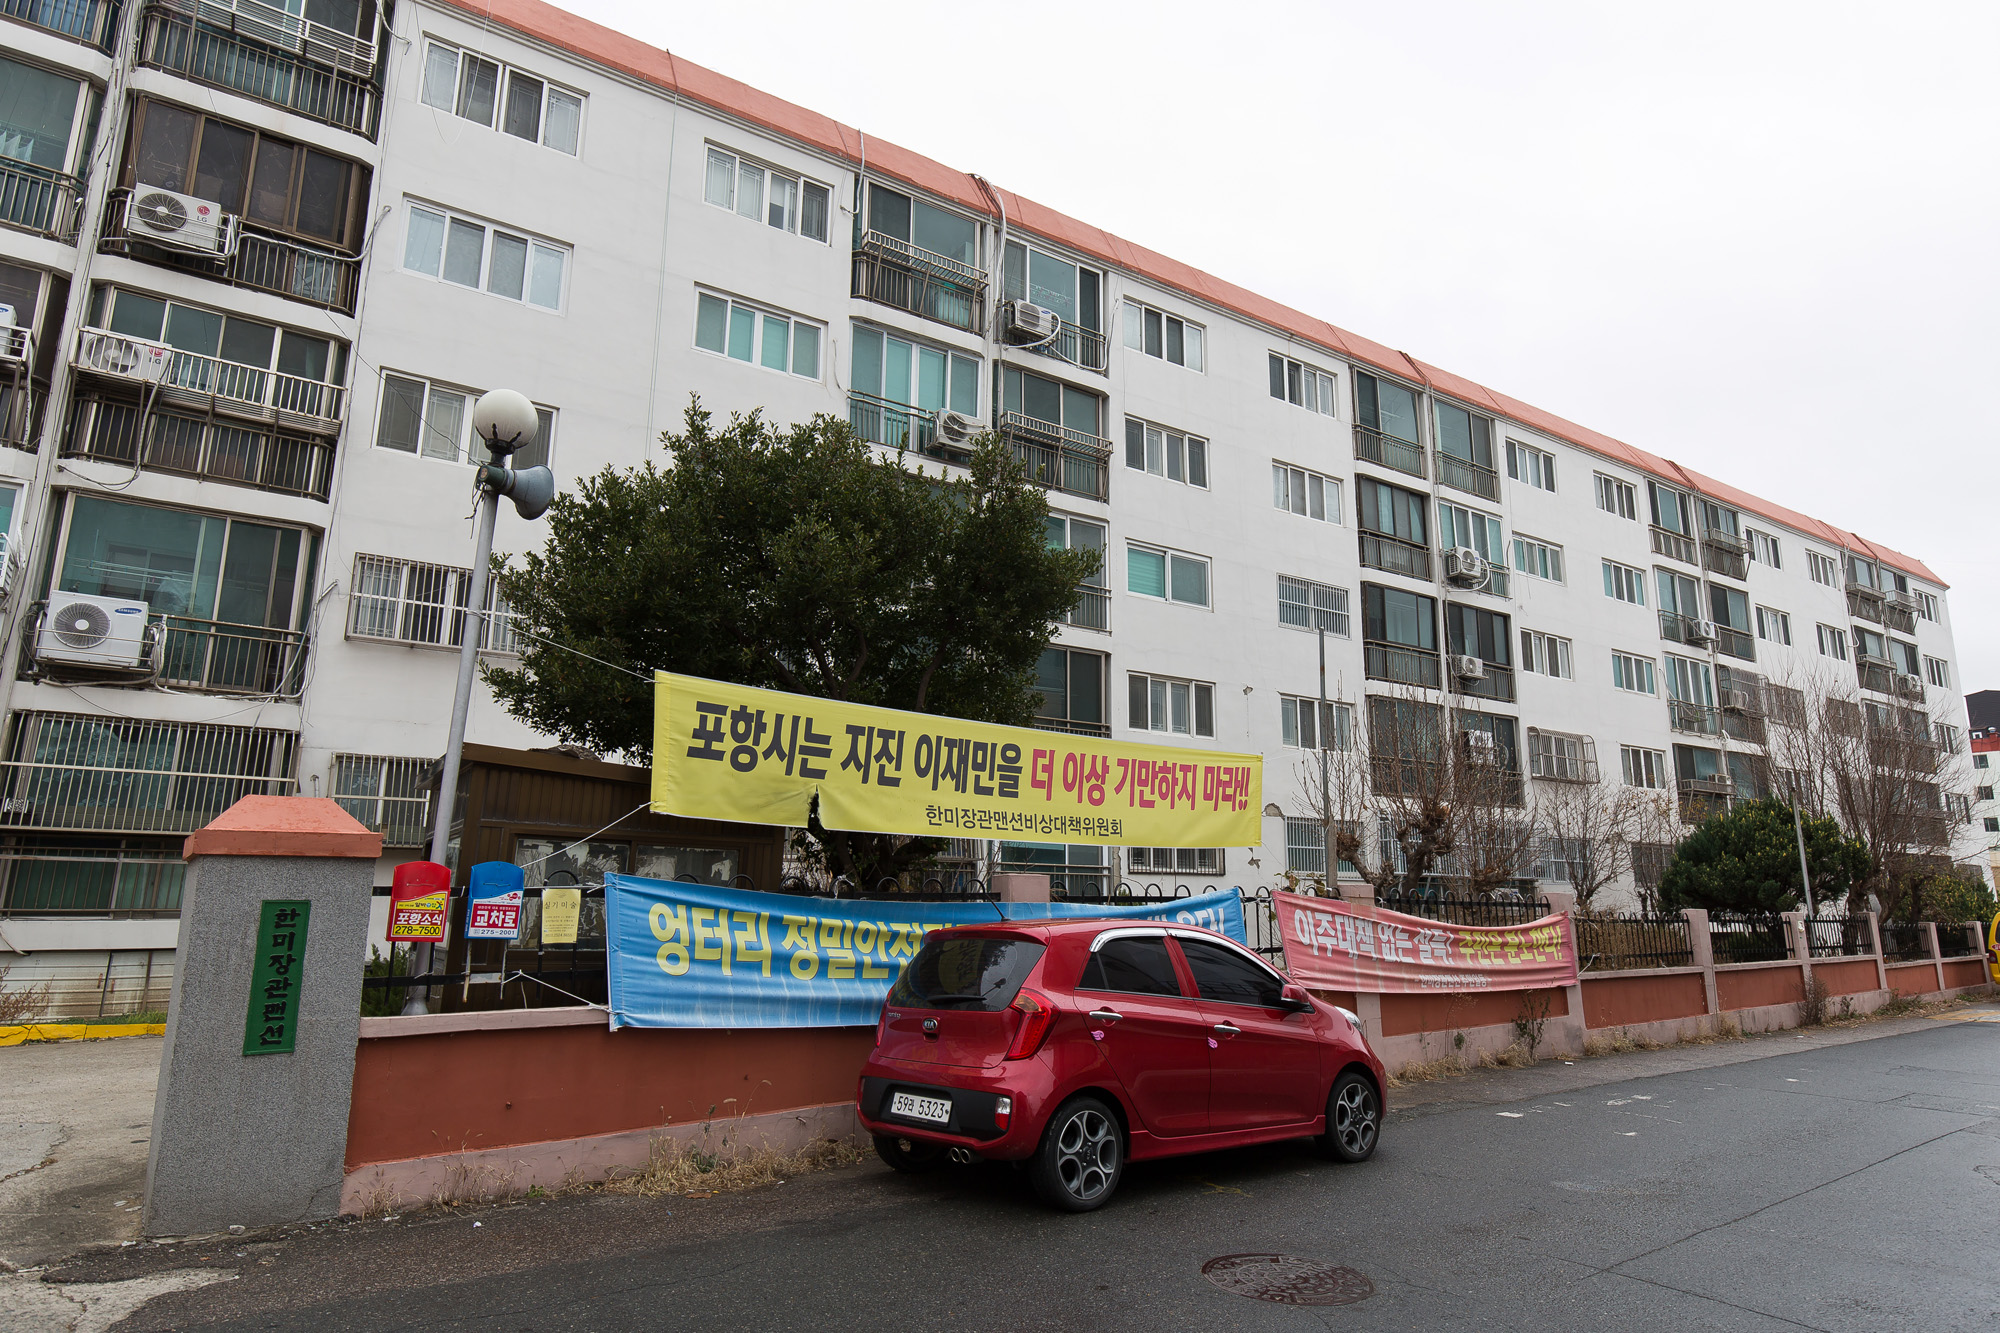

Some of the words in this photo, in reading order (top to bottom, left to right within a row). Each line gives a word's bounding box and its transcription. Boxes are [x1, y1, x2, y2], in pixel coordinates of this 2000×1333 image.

[197, 215, 207, 223] LG
[686, 700, 832, 780] 포항시는
[840, 723, 906, 787] 지진
[914, 733, 1023, 798] 이재민을
[1030, 748, 1056, 801] 더
[1062, 751, 1110, 806] 이상
[1114, 757, 1198, 811] 기만하지
[1203, 764, 1250, 812] 마라!!
[925, 804, 1123, 838] 한미장관맨션비상대책위원회
[396, 912, 443, 926] 포항소식
[474, 910, 516, 927] 교차로
[395, 926, 440, 935] 278-7500
[1294, 908, 1378, 961] 이주대책
[1378, 921, 1416, 963] 없는
[1413, 927, 1455, 966] 설득!
[1458, 930, 1506, 965] 주민은
[1504, 925, 1563, 965] 분노한다!
[649, 902, 772, 978] 엉터리
[781, 914, 970, 980] 정밀안전
[259, 907, 301, 1046] 한미장관맨션
[924, 1020, 935, 1029] KIA
[918, 1099, 946, 1119] 5323
